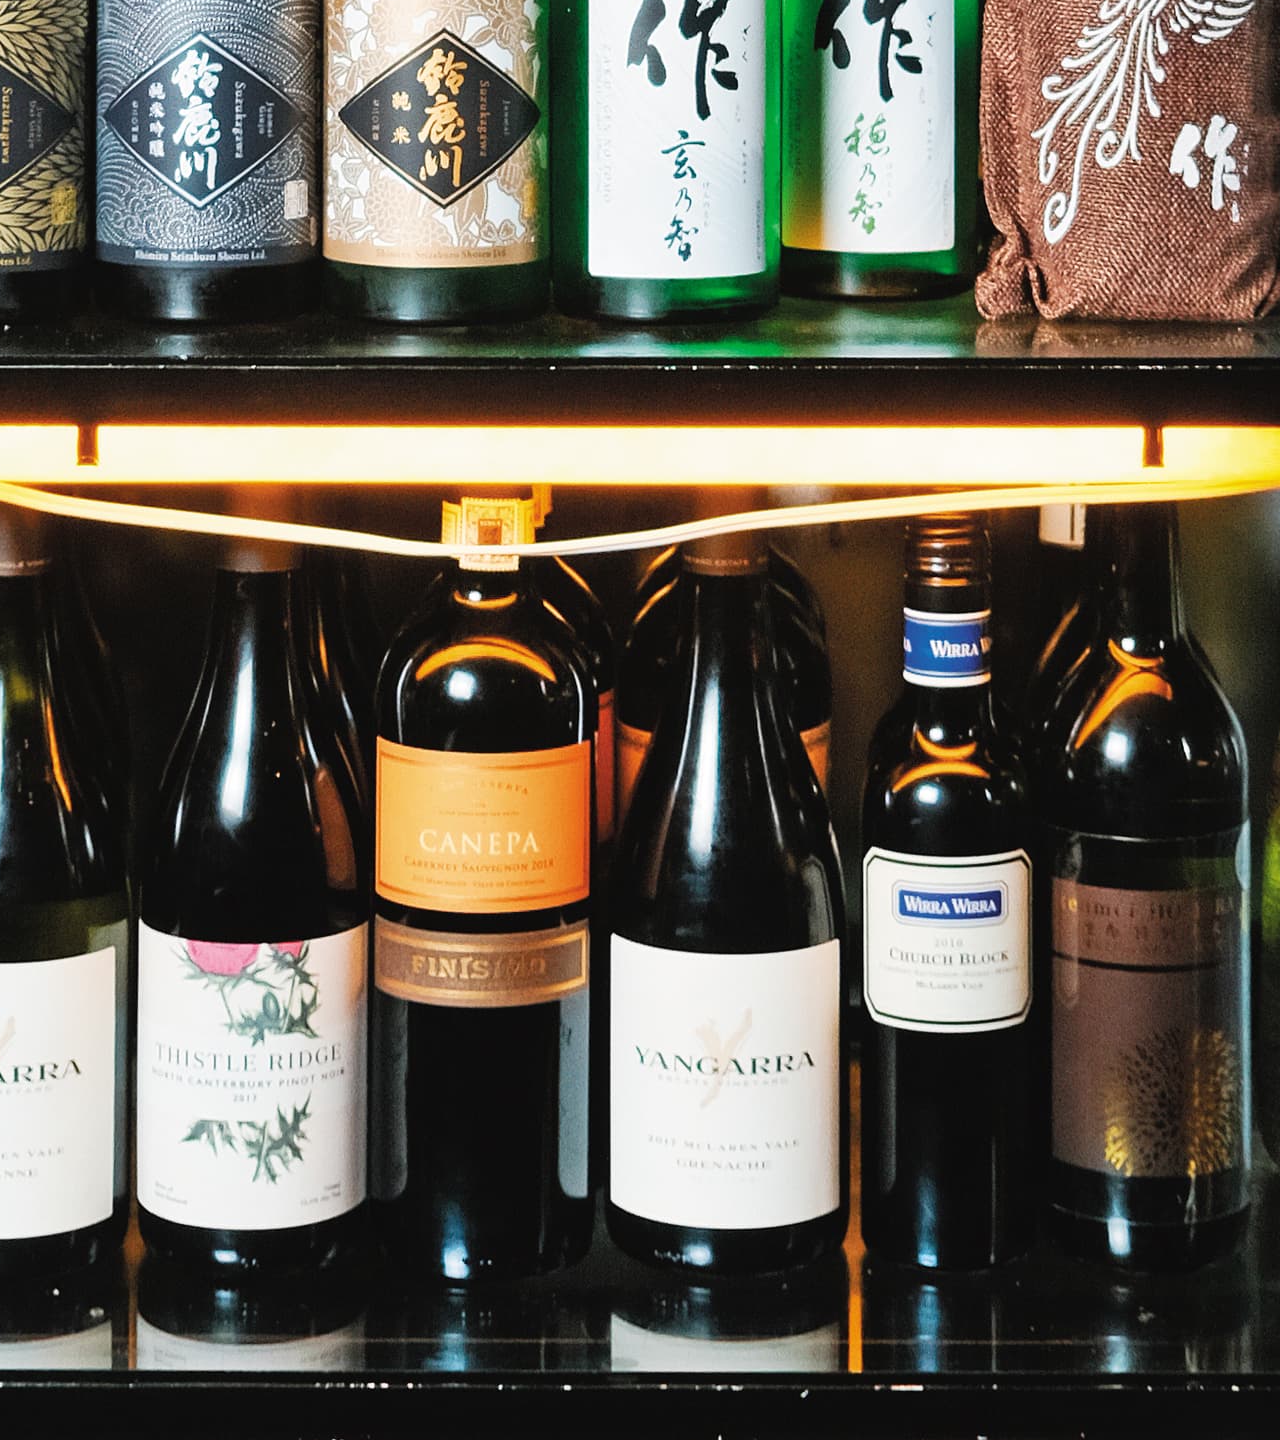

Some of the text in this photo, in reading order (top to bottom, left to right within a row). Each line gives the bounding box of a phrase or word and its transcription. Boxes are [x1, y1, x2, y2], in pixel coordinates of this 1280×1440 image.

[1169, 114, 1241, 211] 作
[929, 639, 980, 659] WIRRA
[419, 828, 540, 856] CANEPA
[903, 894, 997, 915] WIRRA WIRRA
[889, 947, 1010, 966] CHURCH BLOCK
[155, 1041, 343, 1073] THISTLE RIDGE
[635, 1044, 815, 1076] YANGARRA
[187, 1075, 272, 1090] CANTERBURY
[279, 1074, 316, 1088] PINOT
[320, 1066, 346, 1081] NOIR
[676, 1158, 772, 1171] GRENACHE
